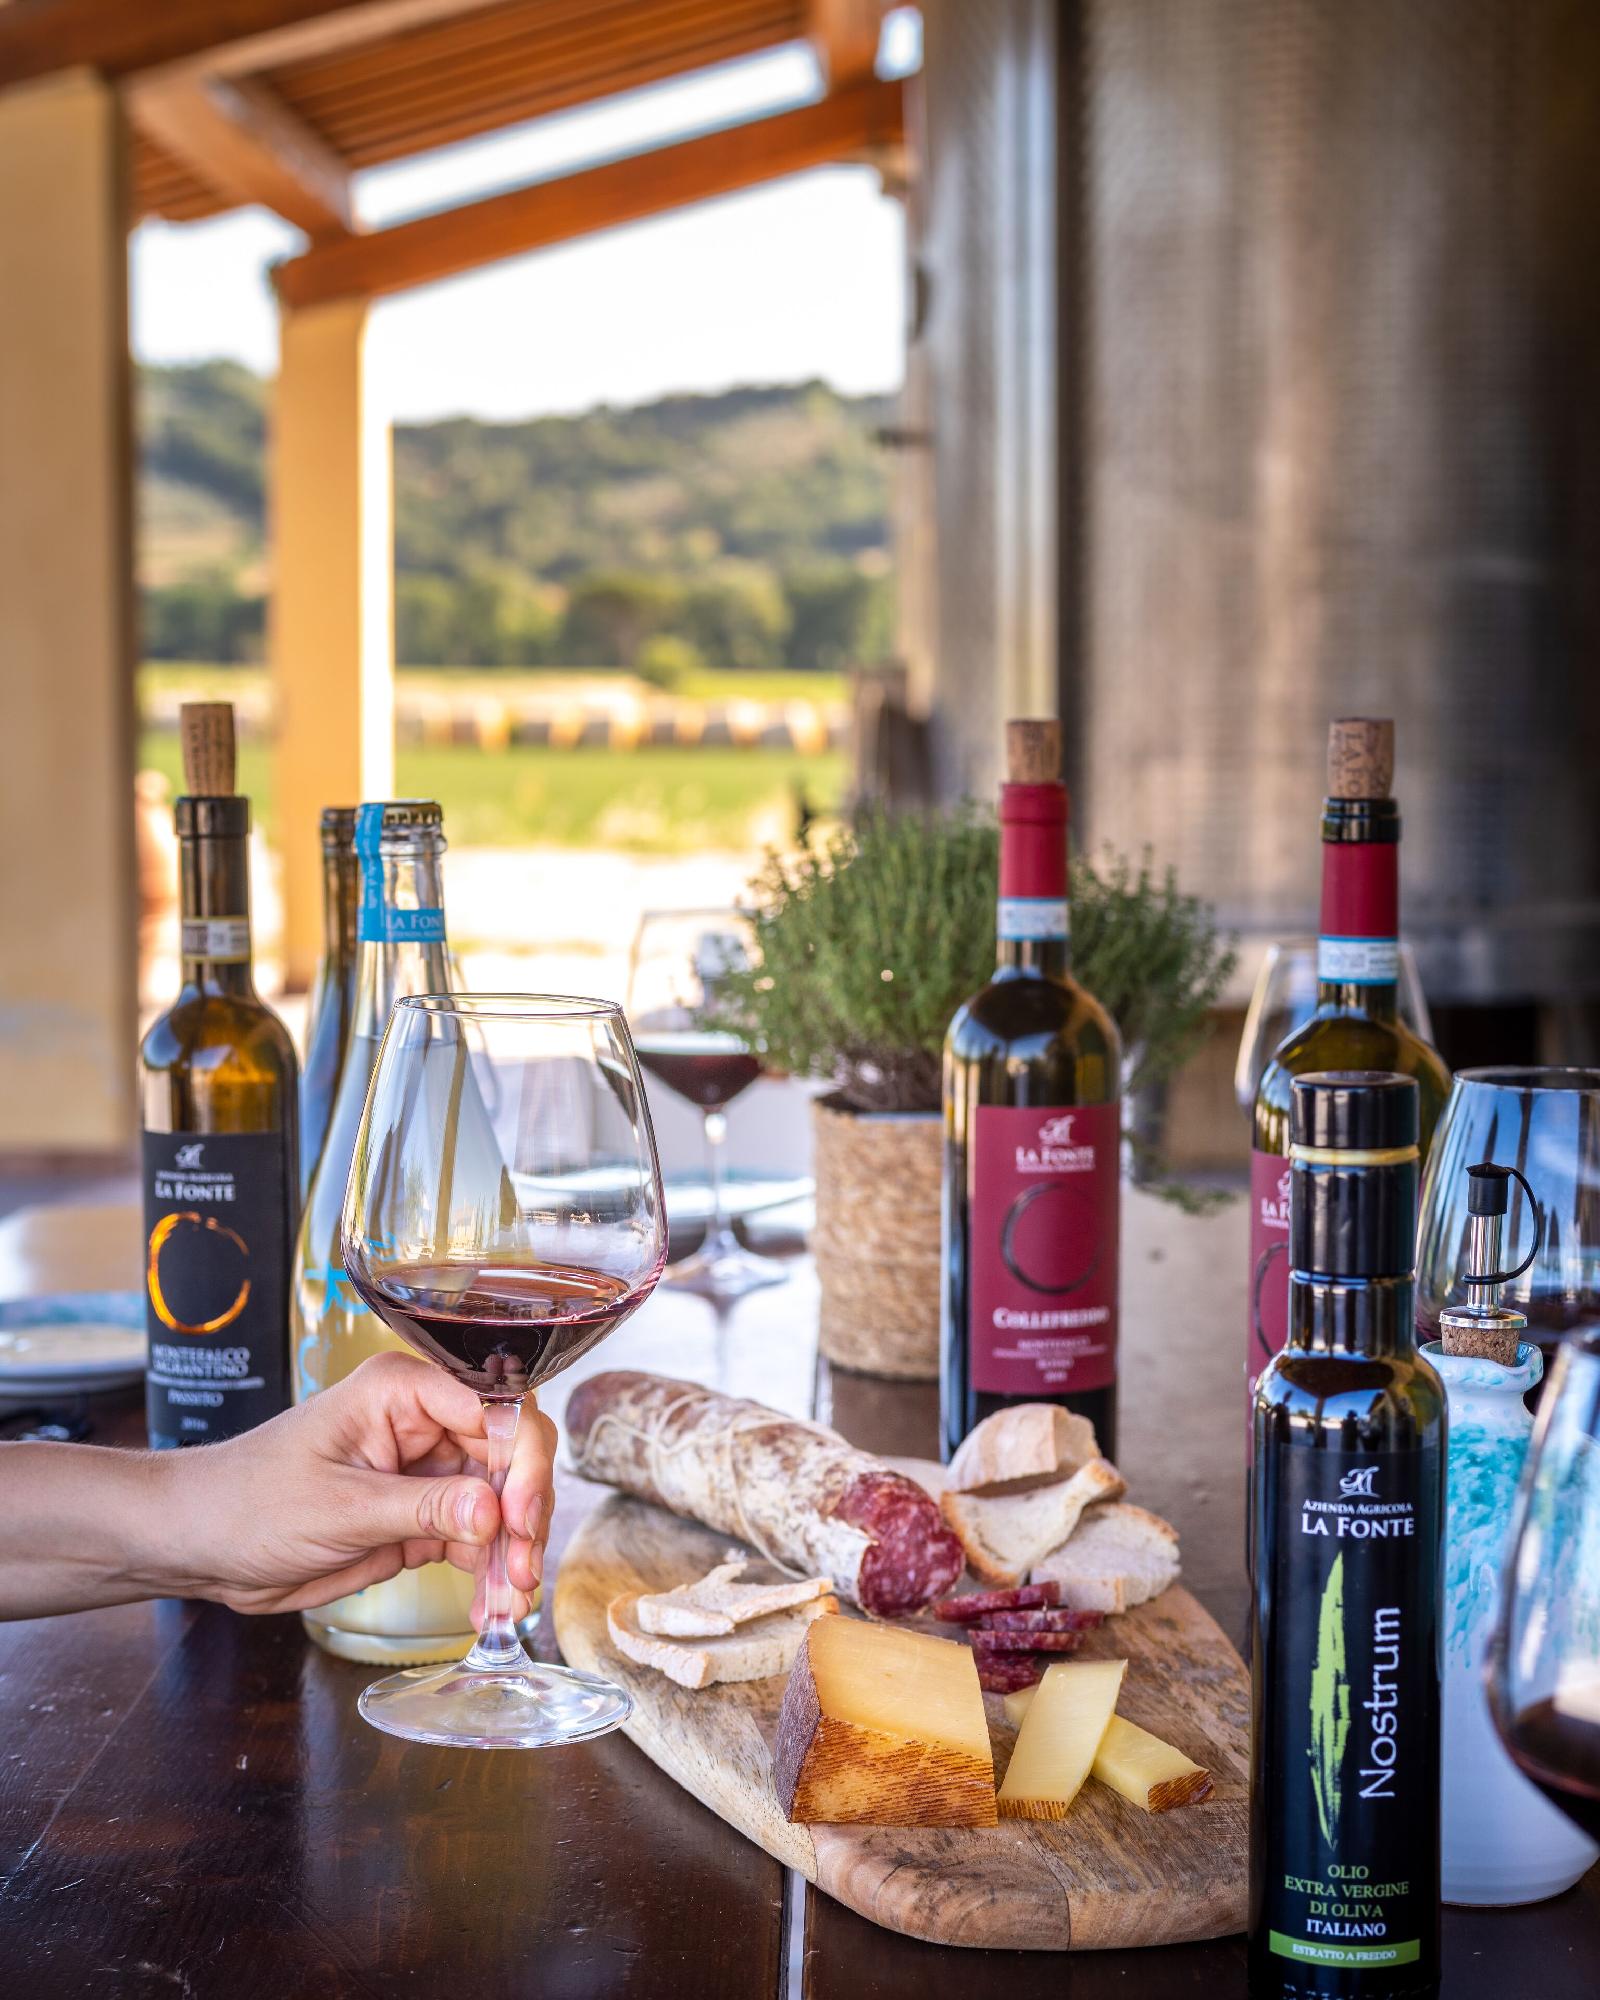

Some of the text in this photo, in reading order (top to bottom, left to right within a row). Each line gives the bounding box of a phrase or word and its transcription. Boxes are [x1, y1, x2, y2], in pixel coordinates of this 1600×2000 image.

[155, 1180, 235, 1201] LA FONTE
[1303, 1499, 1413, 1515] AZIENDA AGRICOLA
[1302, 1513, 1414, 1538] LA FONTE
[1358, 1606, 1400, 1799] Nostrum
[1327, 1864, 1369, 1879] OLIO
[1284, 1875, 1409, 1898] EXTRA VERGINE
[1310, 1900, 1384, 1918] DI OLIVA
[1306, 1918, 1387, 1937] ITALIANO
[1292, 1943, 1398, 1961] ESTRATTO A FREDDO
